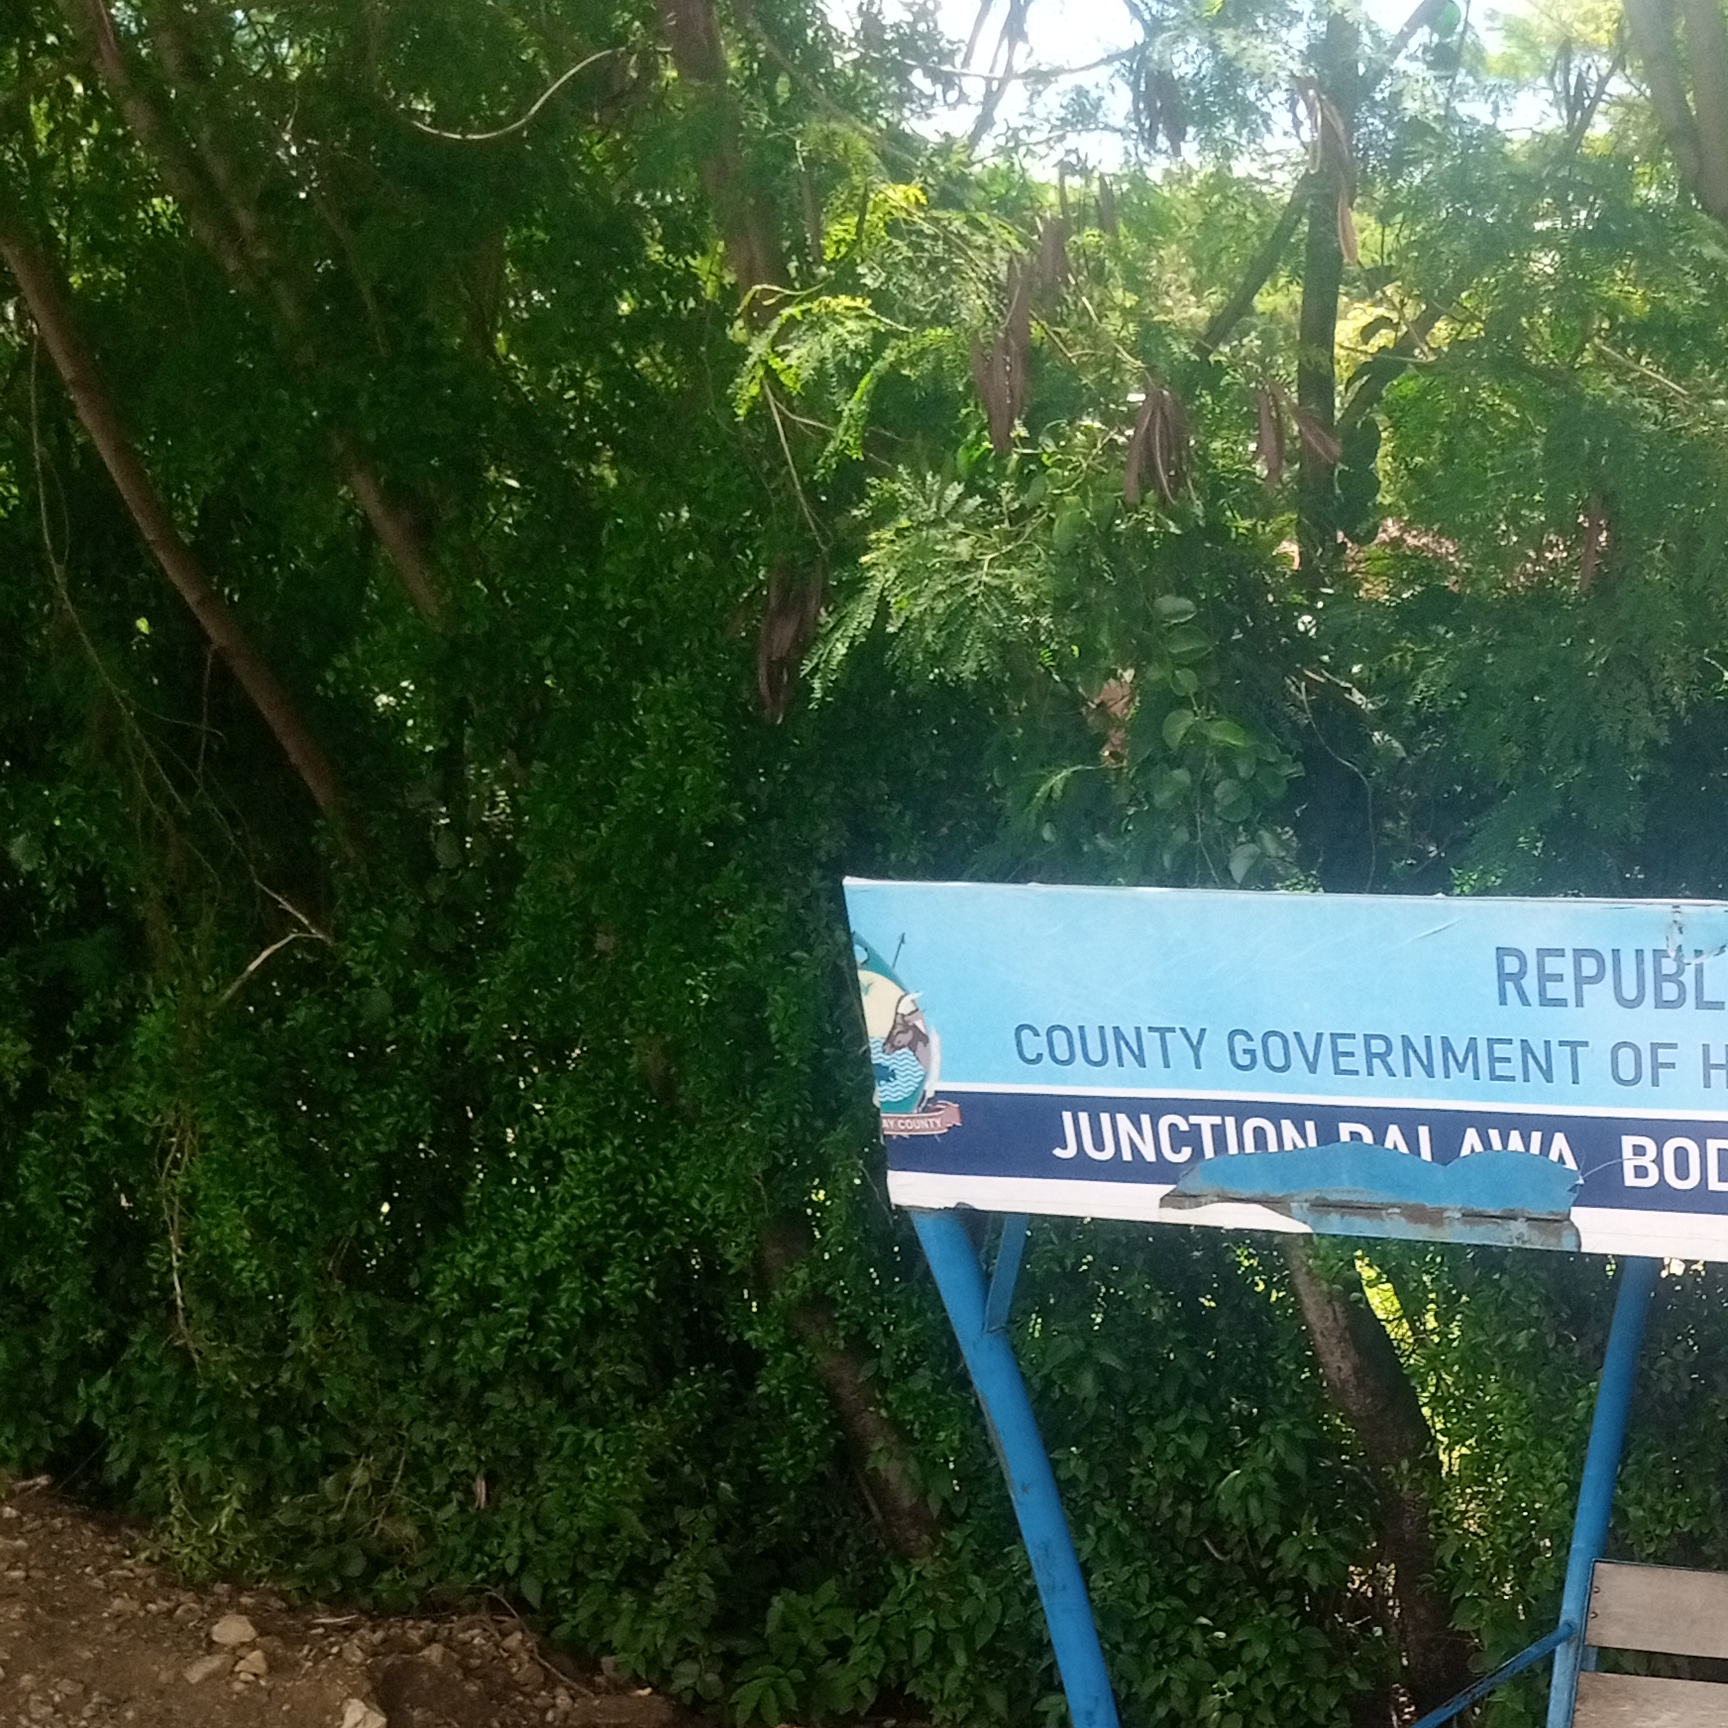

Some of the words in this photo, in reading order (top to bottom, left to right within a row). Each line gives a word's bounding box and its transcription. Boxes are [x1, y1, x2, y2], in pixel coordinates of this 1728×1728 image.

[1014, 1023, 1207, 1071] COUNTY
[1227, 1029, 1588, 1086] GOVERNMENT
[1610, 1041, 1677, 1089] OF
[897, 1117, 942, 1130] COUNTY
